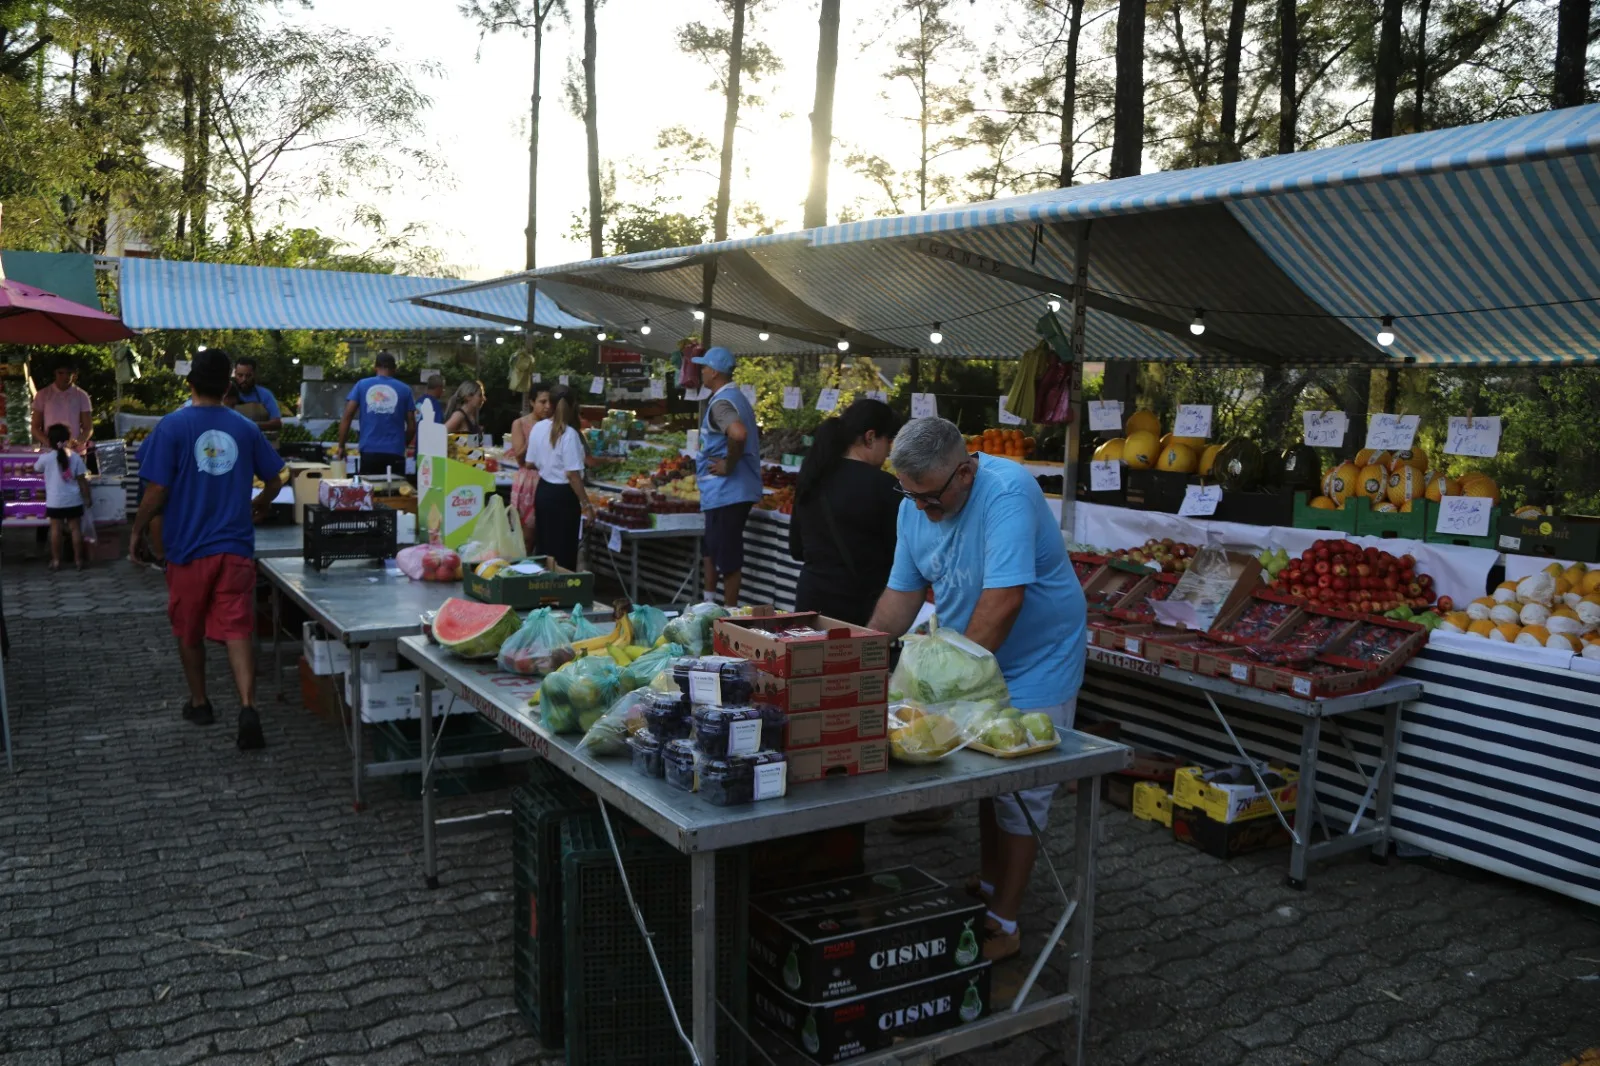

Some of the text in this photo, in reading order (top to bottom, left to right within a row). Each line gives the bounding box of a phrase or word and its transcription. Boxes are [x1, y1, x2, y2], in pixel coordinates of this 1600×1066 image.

[901, 238, 1002, 273] IGANTE
[1072, 266, 1086, 391] GIGANTE
[868, 937, 947, 970] CISNE
[877, 995, 952, 1031] CISNE
